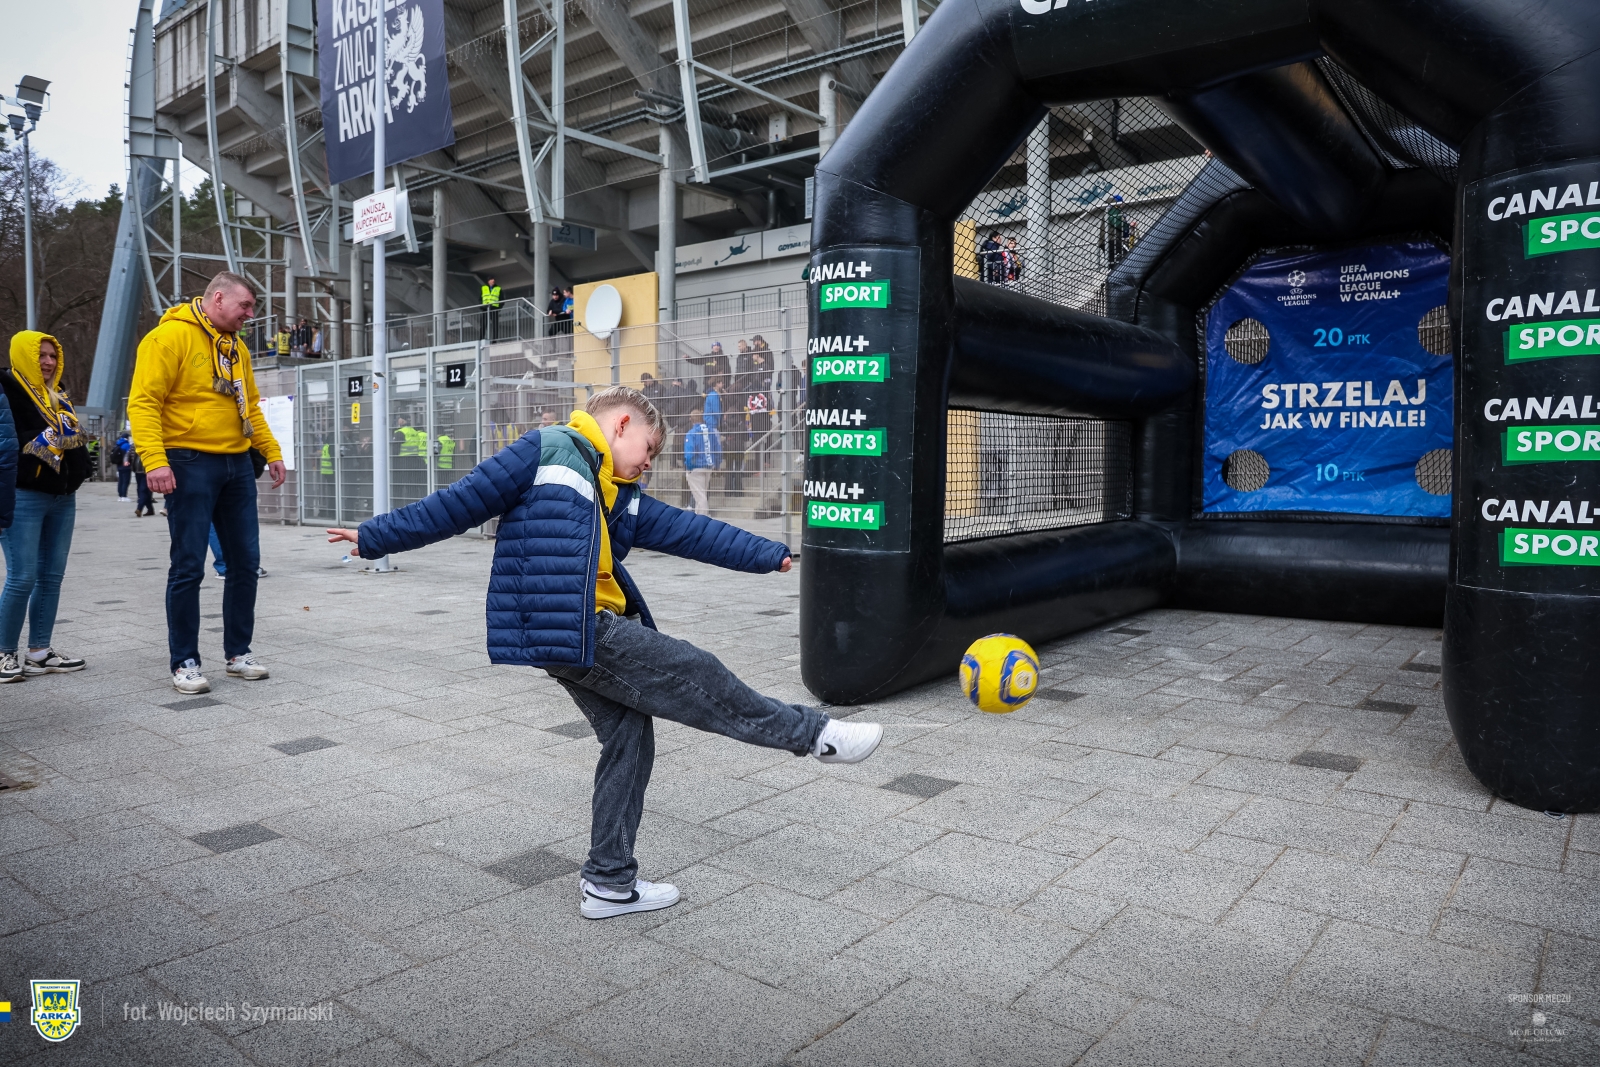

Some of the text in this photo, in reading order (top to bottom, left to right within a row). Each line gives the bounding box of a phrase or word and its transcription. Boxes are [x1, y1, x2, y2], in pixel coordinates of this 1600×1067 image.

[333, 21, 378, 91] ZNAC
[337, 78, 394, 143] ARKA
[361, 202, 386, 218] JANUSZA
[355, 211, 393, 231] KUPCEWICZA
[809, 261, 872, 284] CANAL+
[1340, 264, 1367, 274] UEFA
[1340, 269, 1410, 283] CHAMPIONS
[825, 285, 882, 302] SPORT
[1340, 281, 1381, 293] LEAGUE
[1340, 289, 1401, 302] W CANAL+
[1277, 293, 1317, 302] CHAMPIONS
[1284, 299, 1310, 307] LEAGUE
[807, 335, 870, 355] CANAL+
[1313, 327, 1371, 347] 20 PTK
[450, 368, 461, 382] 12
[1261, 379, 1427, 409] STRZELAJ
[805, 408, 867, 426] CANAL+
[1484, 395, 1600, 422] CANAL
[1259, 410, 1427, 430] JAK W FINALE!
[1315, 463, 1365, 482] 10 PTK
[803, 480, 865, 500] CANAL+
